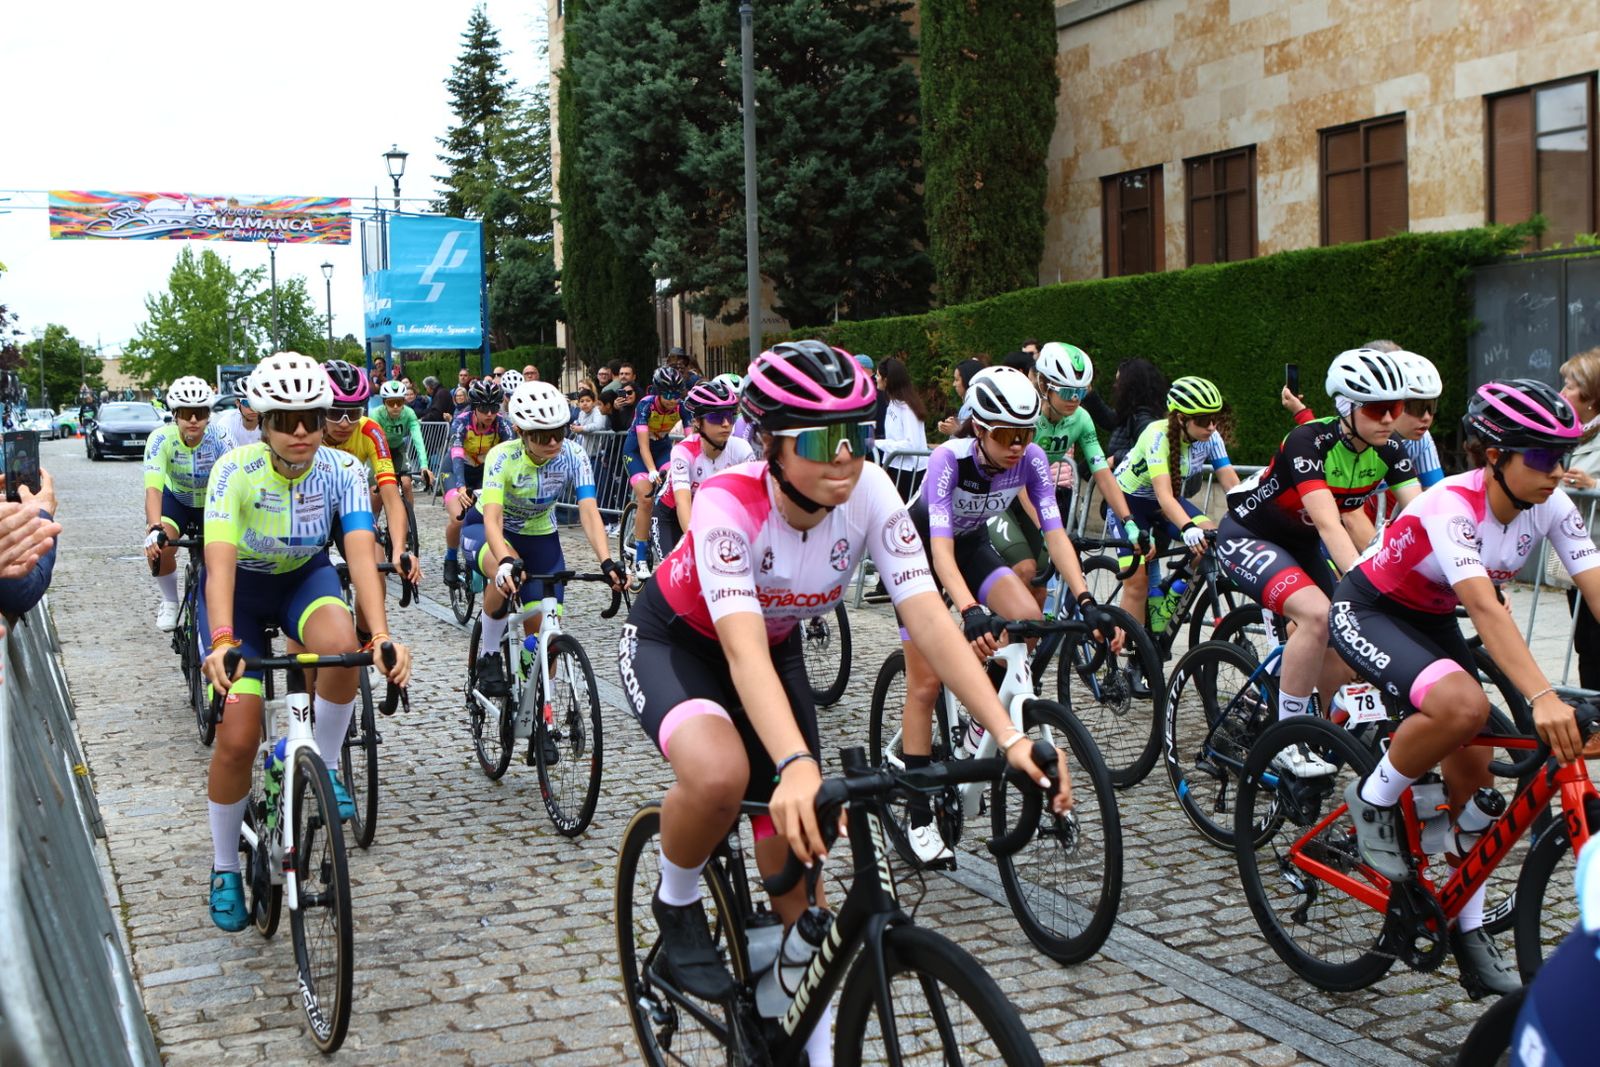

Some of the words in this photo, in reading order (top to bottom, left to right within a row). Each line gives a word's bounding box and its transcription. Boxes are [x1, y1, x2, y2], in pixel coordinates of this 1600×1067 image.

[195, 214, 314, 232] SALAMANCA
[214, 462, 239, 498] aqualia
[955, 496, 1011, 512] SAVOY
[1244, 477, 1280, 513] OVIEDO
[1334, 601, 1391, 670] Penacova
[618, 623, 646, 714] Penacova
[1354, 694, 1375, 711] 78
[866, 812, 898, 901] GIANT
[1440, 783, 1541, 912] SCOTT
[783, 919, 843, 1037] GIANT
